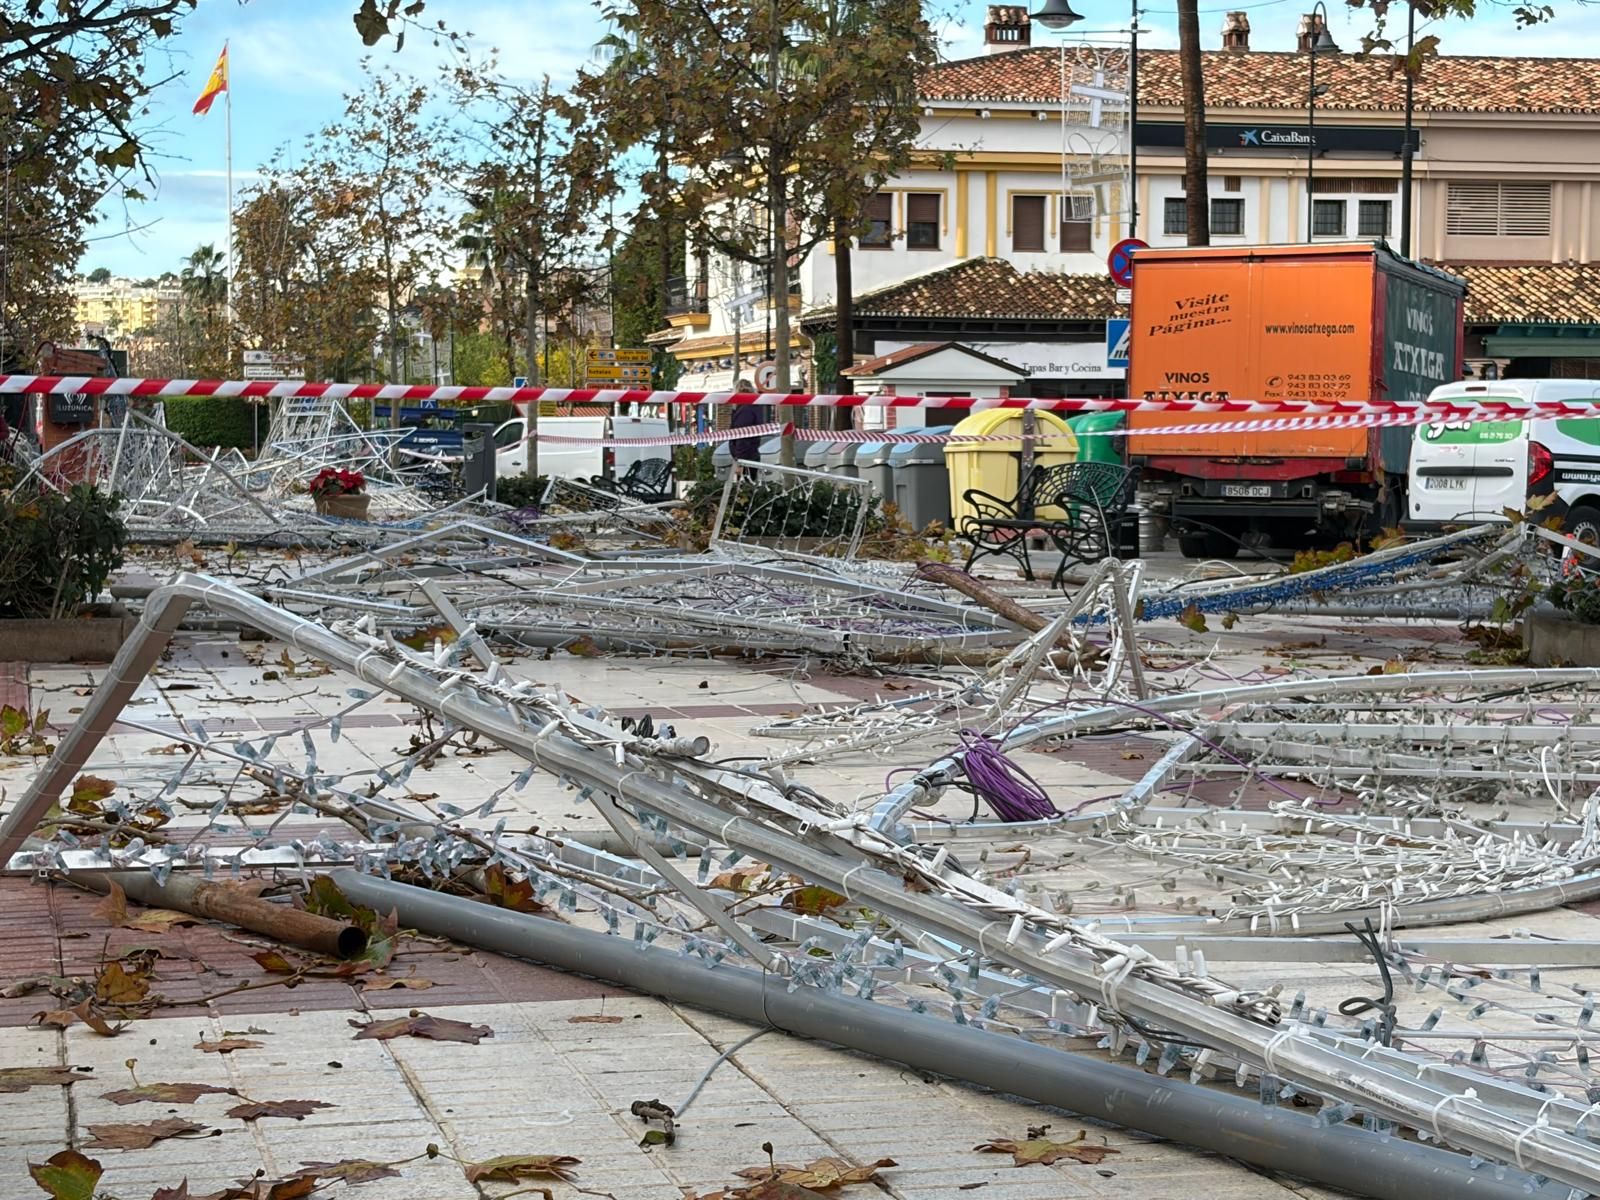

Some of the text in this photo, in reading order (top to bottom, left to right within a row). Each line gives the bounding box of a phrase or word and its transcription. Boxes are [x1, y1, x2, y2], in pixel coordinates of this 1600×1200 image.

[1175, 294, 1229, 310] Visite
[1169, 305, 1230, 322] nuestra
[1406, 307, 1433, 336] VINOS
[1265, 322, 1355, 338] www.vinosatxega.com
[1022, 363, 1101, 374] Tapas Bar y Cocina
[1393, 341, 1445, 381] ATXEGA
[1165, 372, 1210, 384] VINOS
